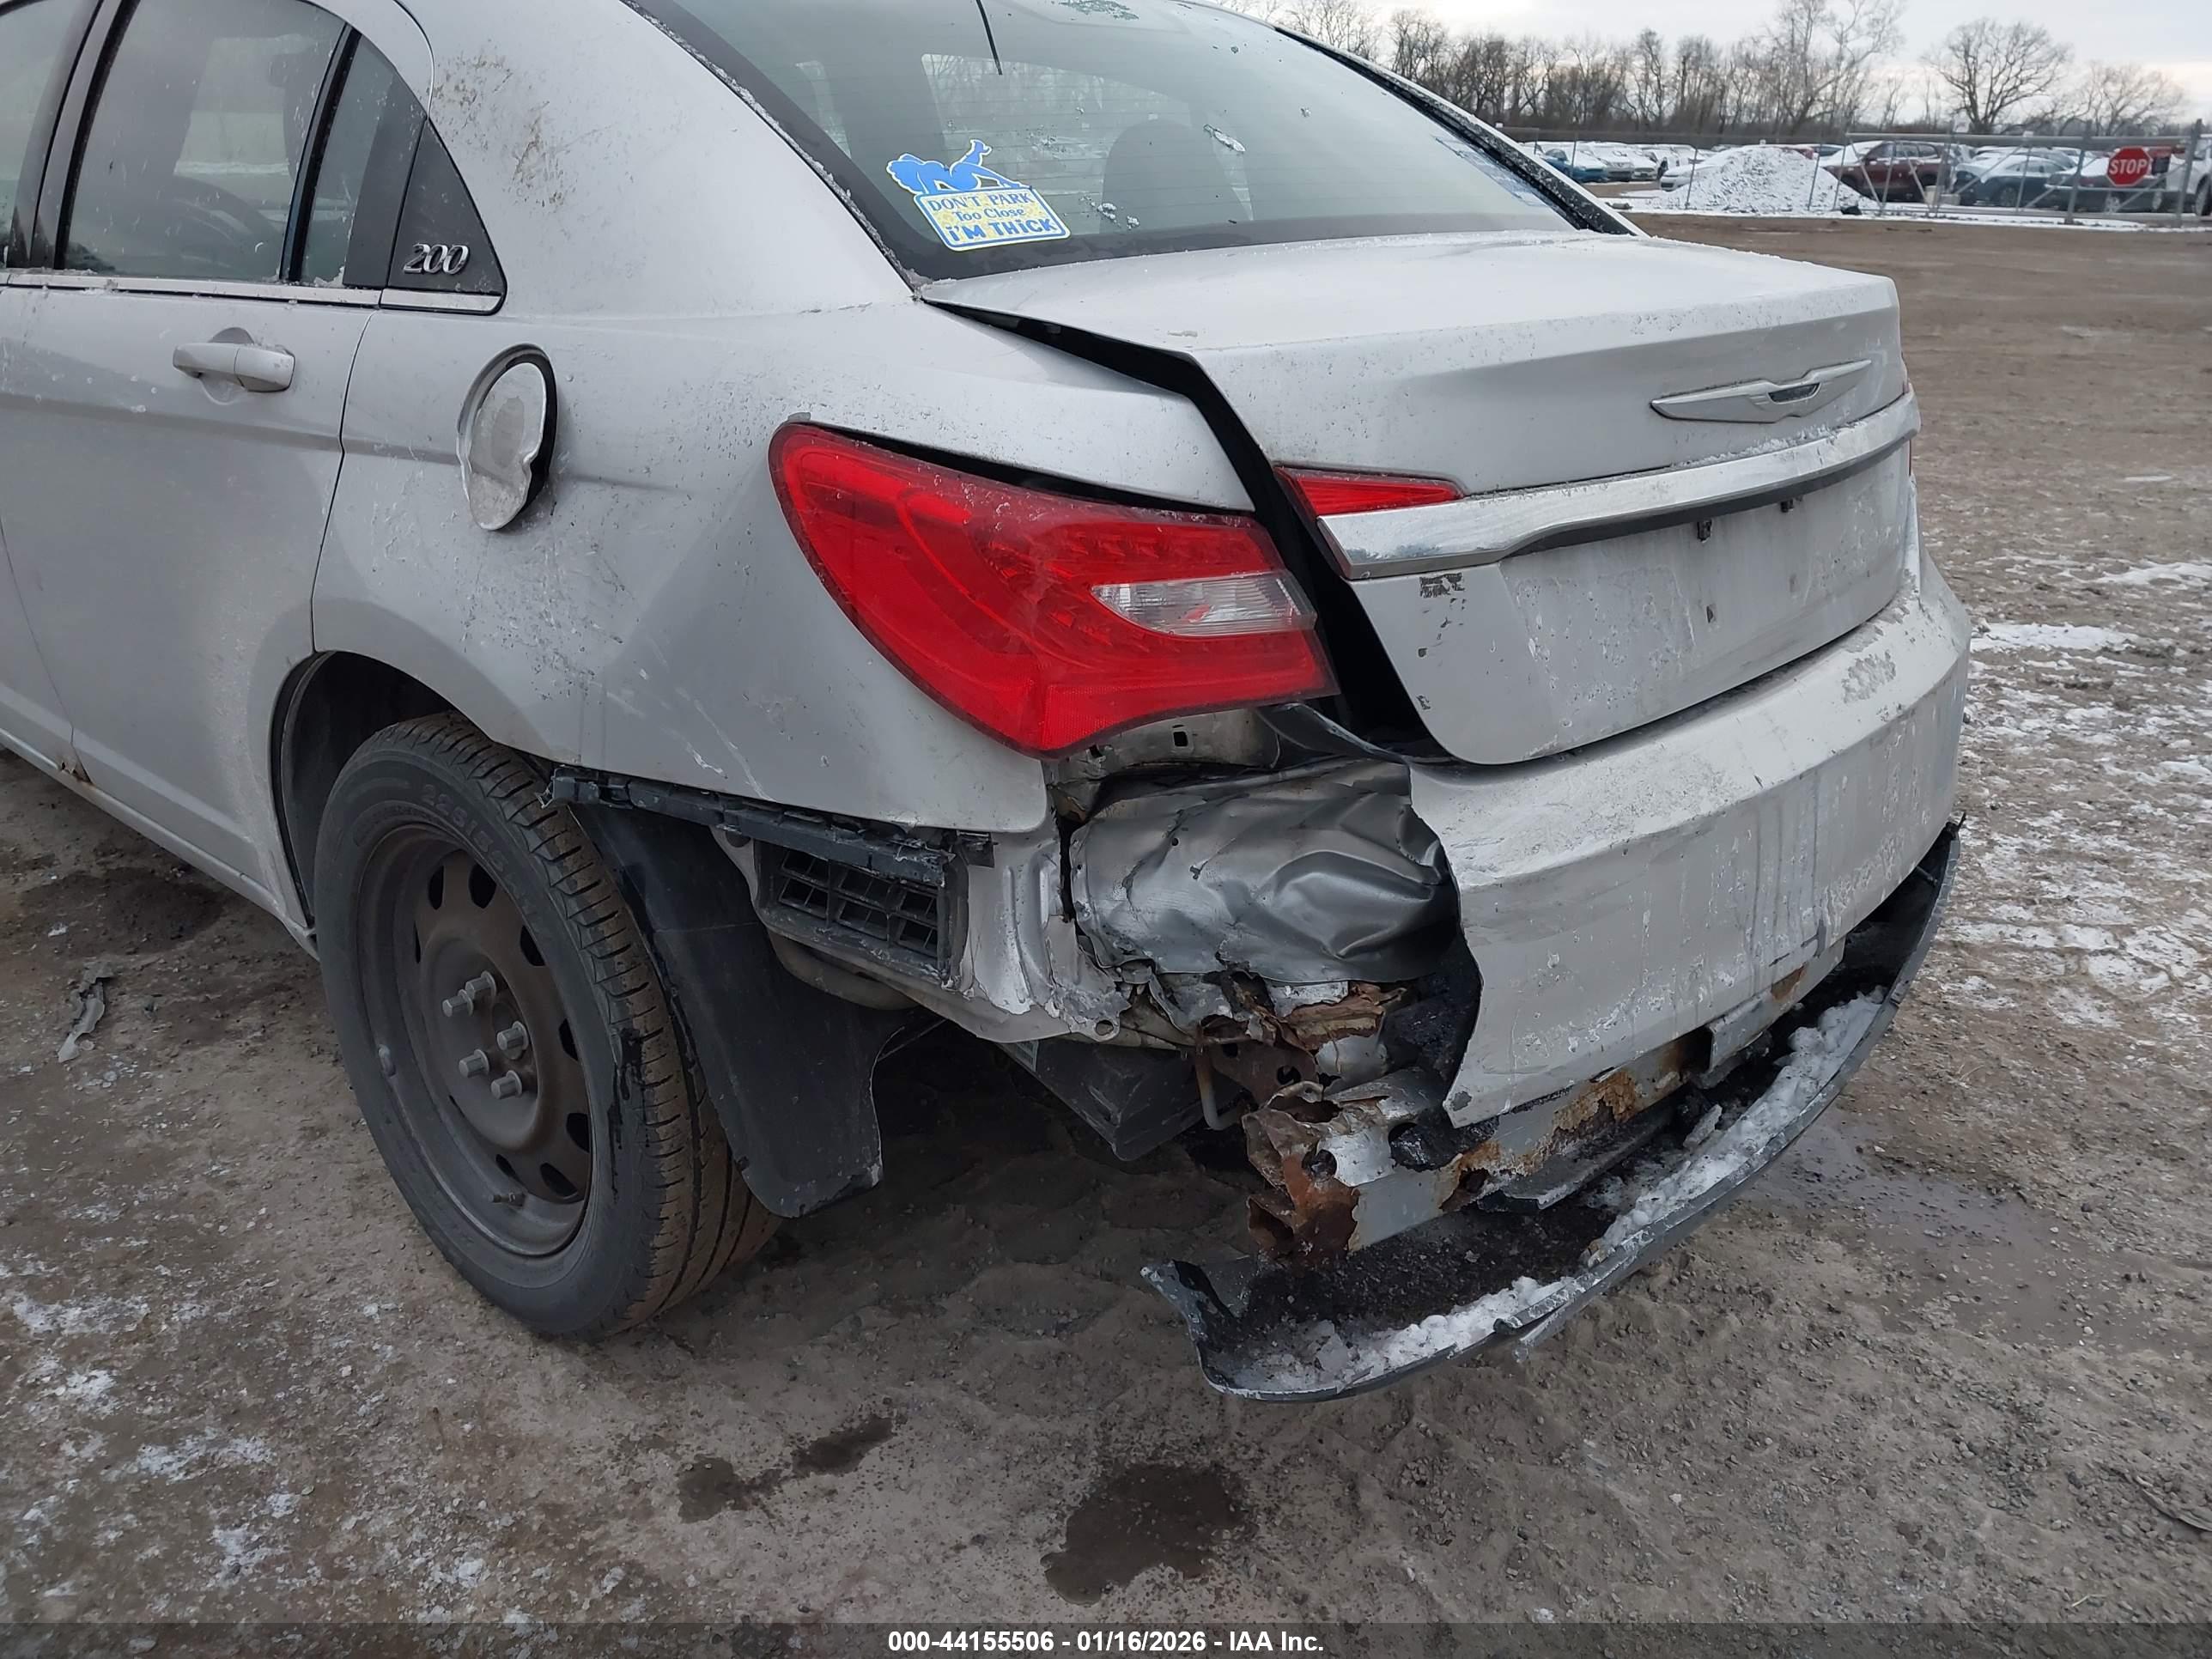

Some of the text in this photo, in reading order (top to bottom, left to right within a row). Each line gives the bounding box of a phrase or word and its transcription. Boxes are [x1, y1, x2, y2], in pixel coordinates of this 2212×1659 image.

[2109, 159, 2147, 174] STOP
[927, 192, 1033, 211] DON'T PARK
[952, 208, 1026, 222] Too Close
[404, 243, 468, 274] 200
